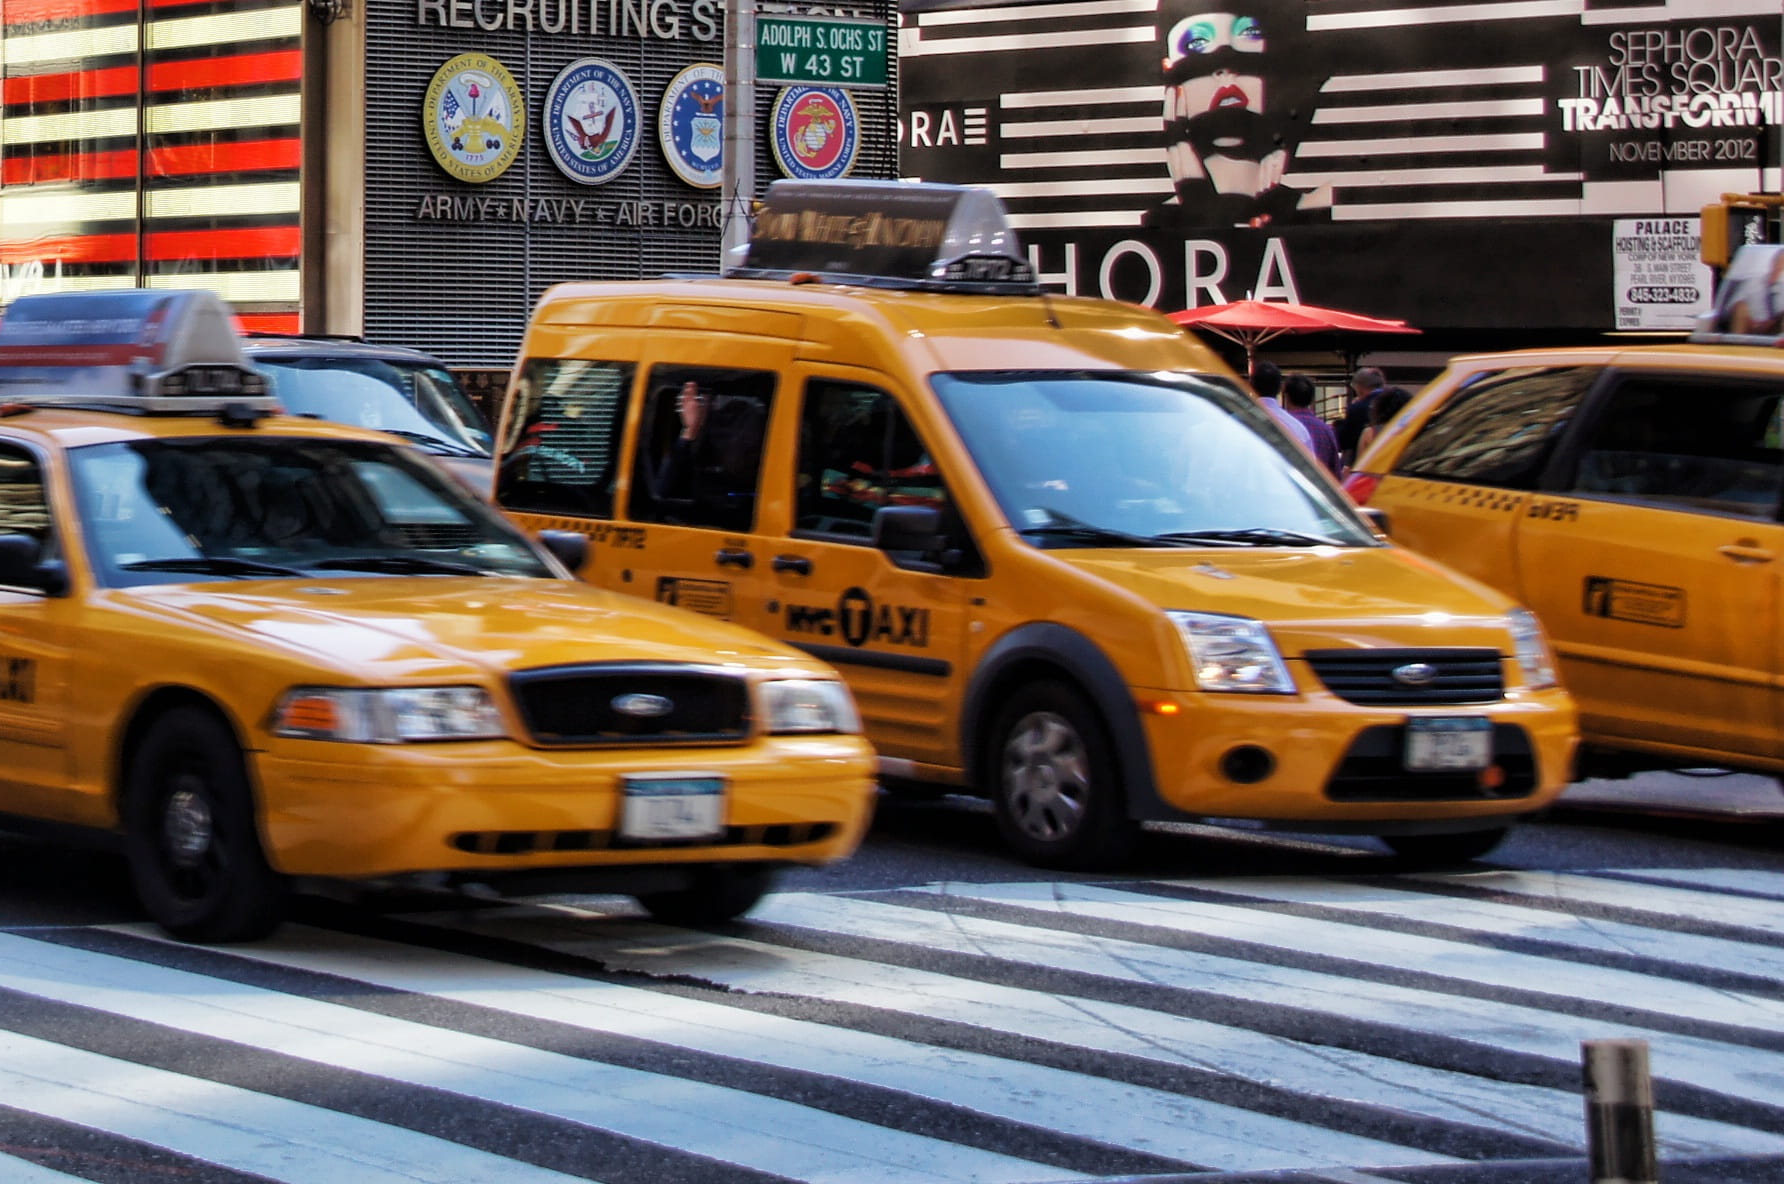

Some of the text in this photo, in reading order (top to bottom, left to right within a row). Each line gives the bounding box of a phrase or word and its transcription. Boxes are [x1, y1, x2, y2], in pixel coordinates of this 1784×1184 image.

[760, 24, 884, 53] ADOLPH S. OCHS ST
[1608, 26, 1764, 66] SEPHORA
[693, 69, 706, 78] OF
[780, 53, 864, 78] W 43 ST
[1573, 57, 1783, 98] TIMES SQUAR
[429, 59, 508, 108] DEPARTMENT OF THE
[552, 71, 591, 114] DEPARTMENT
[593, 69, 605, 80] OF
[606, 72, 621, 89] THE
[1558, 90, 1784, 132] TRANSFORMI
[552, 126, 573, 163] UNITED
[567, 157, 597, 175] STATES
[597, 163, 608, 174] OF
[1609, 139, 1757, 162] NOVEMBER 2012
[447, 160, 497, 178] STATES OF
[418, 195, 653, 225] ARMY NAVY AIR
[1636, 220, 1690, 235] PALACE
[1616, 236, 1650, 252] HOISTING
[1659, 253, 1675, 261] NEW
[1678, 253, 1697, 261] YORK
[1028, 237, 1302, 310] HORA
[1670, 262, 1692, 273] STREET
